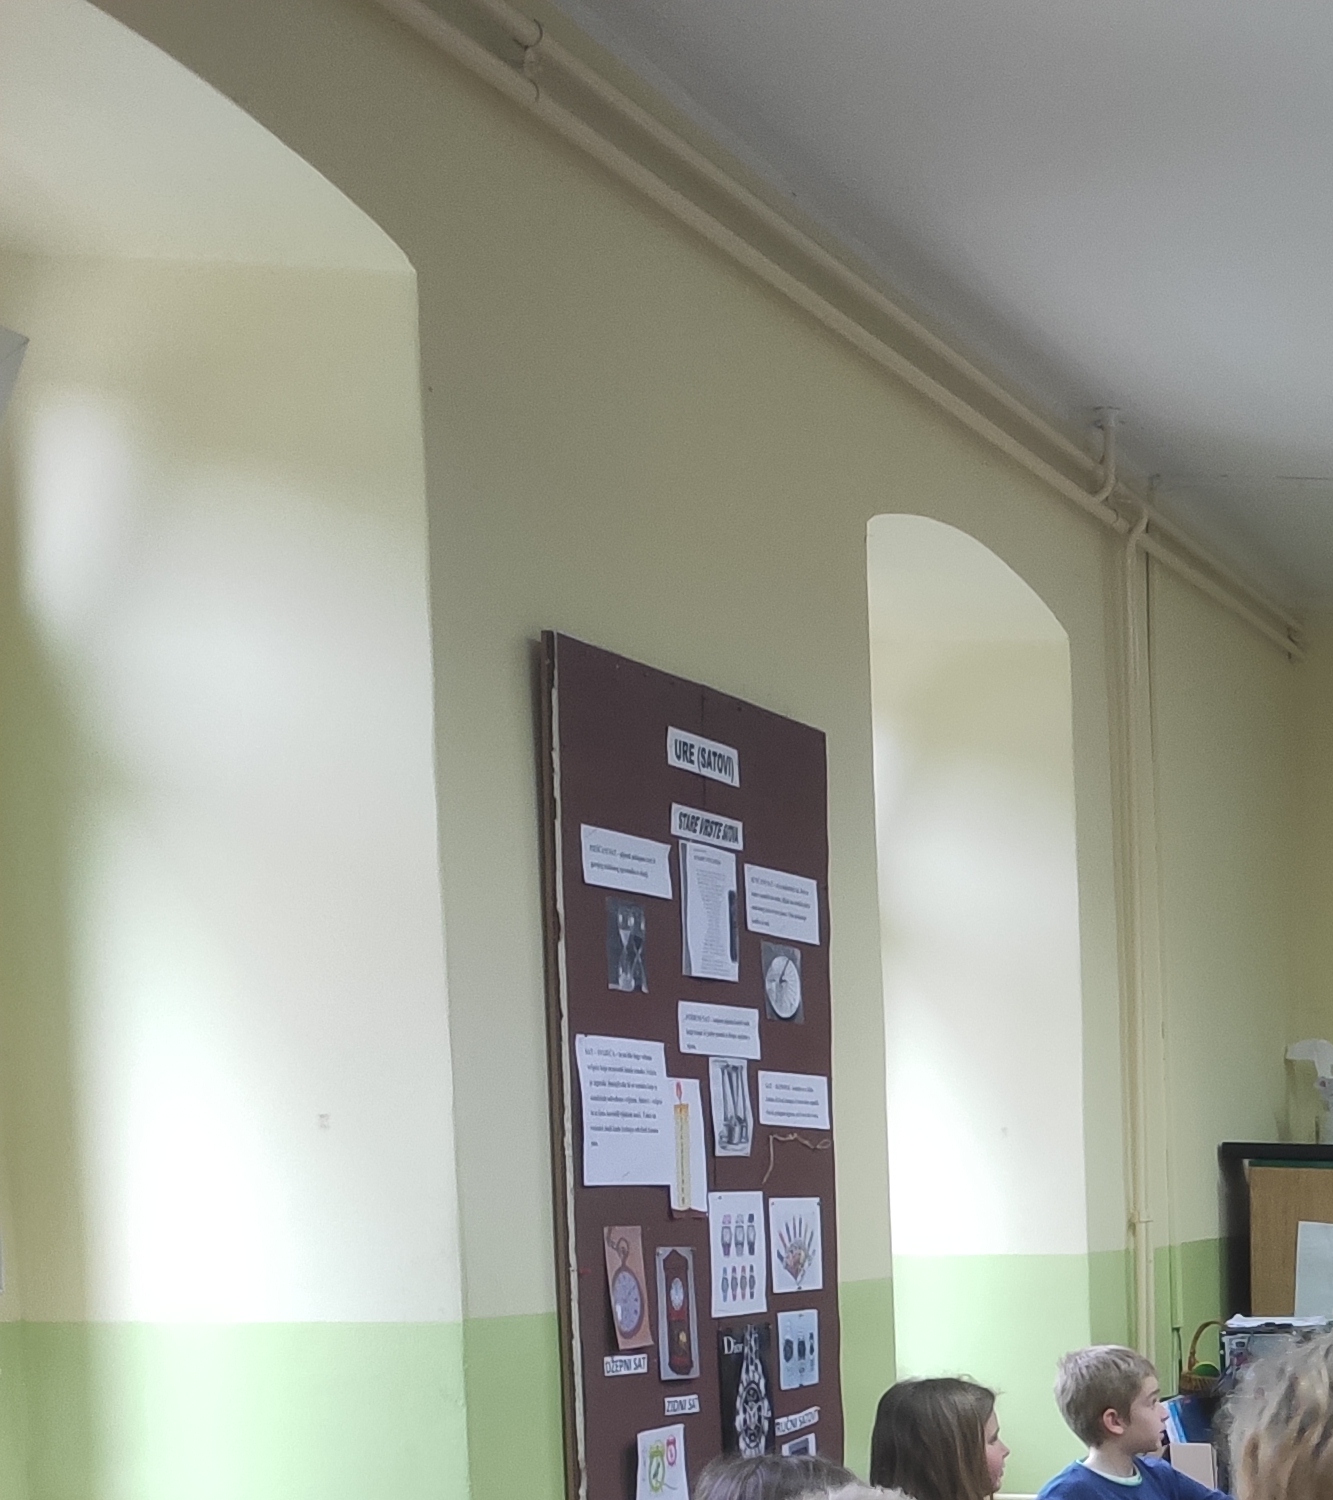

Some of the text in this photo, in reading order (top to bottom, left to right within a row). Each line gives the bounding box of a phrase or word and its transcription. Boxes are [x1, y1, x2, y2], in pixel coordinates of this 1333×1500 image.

[674, 738, 735, 783] URE (SATOVI)
[678, 811, 699, 834] STARE
